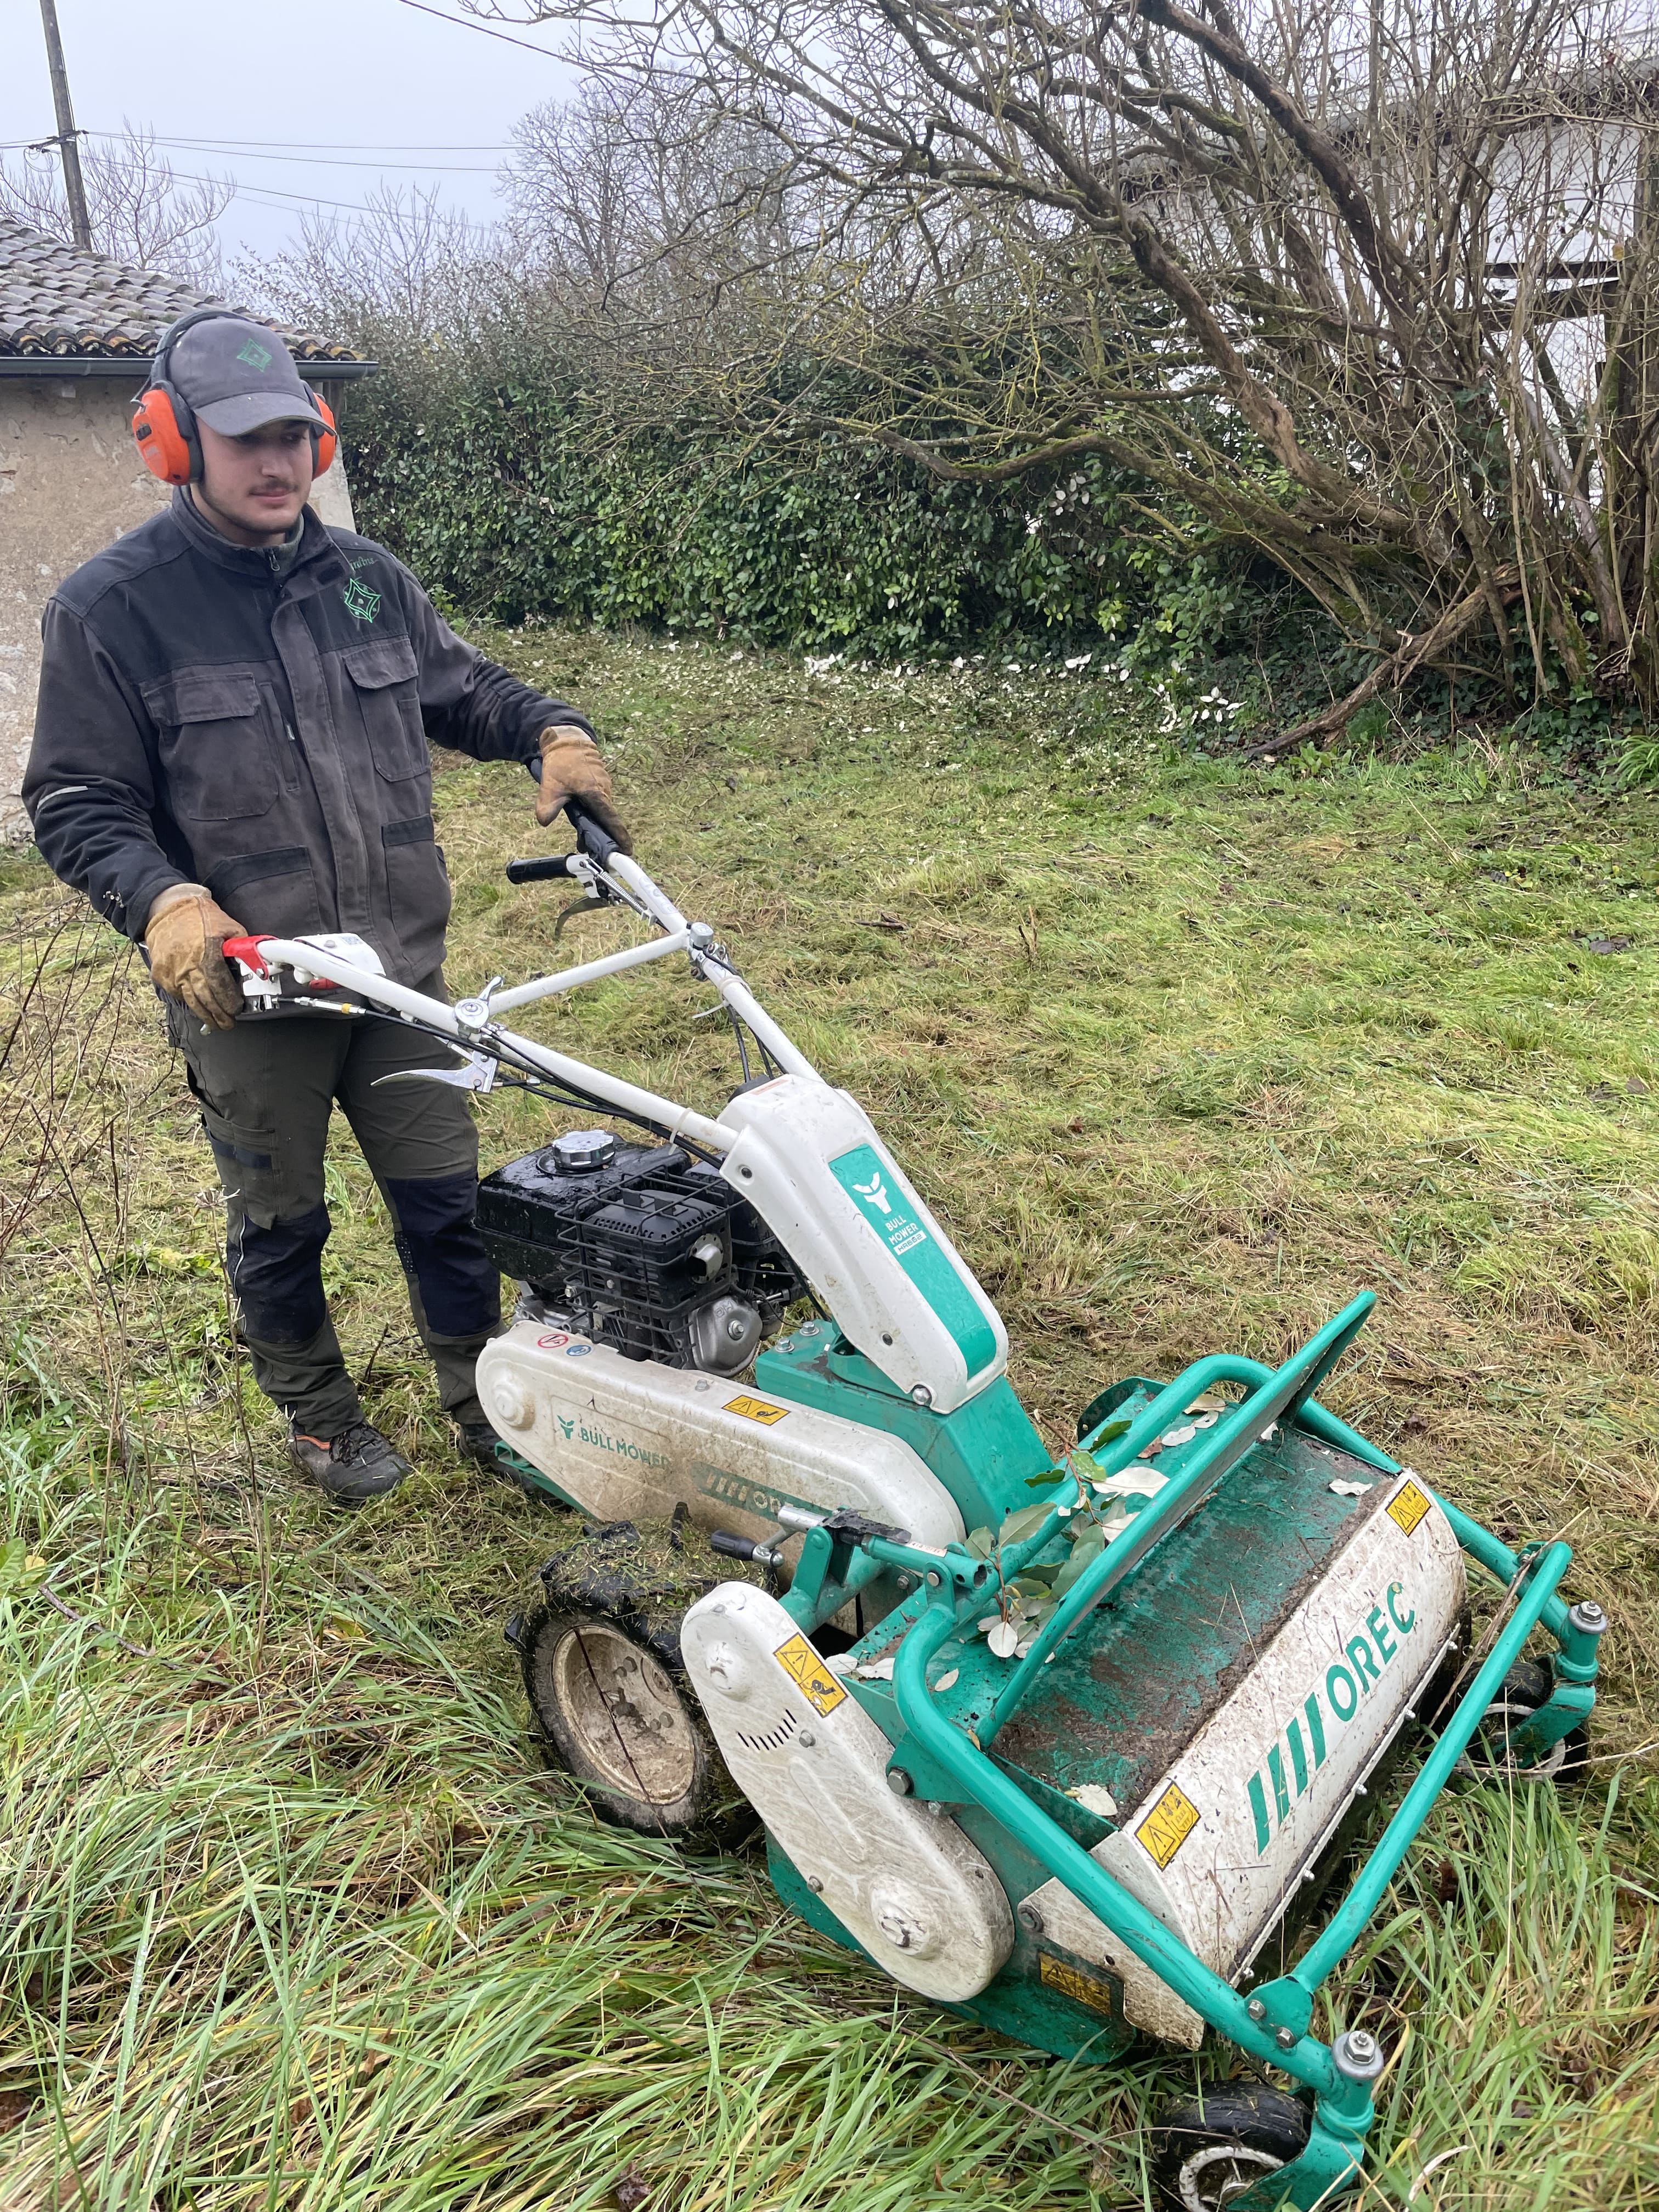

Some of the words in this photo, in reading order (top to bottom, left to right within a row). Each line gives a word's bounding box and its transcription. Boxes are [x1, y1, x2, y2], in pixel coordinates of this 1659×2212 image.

[885, 1215, 907, 1232] BULL
[888, 1222, 919, 1245] MOWER
[898, 1233, 923, 1252] HR662
[580, 1427, 614, 1452] BULL
[1325, 1581, 1415, 1722] OREC
